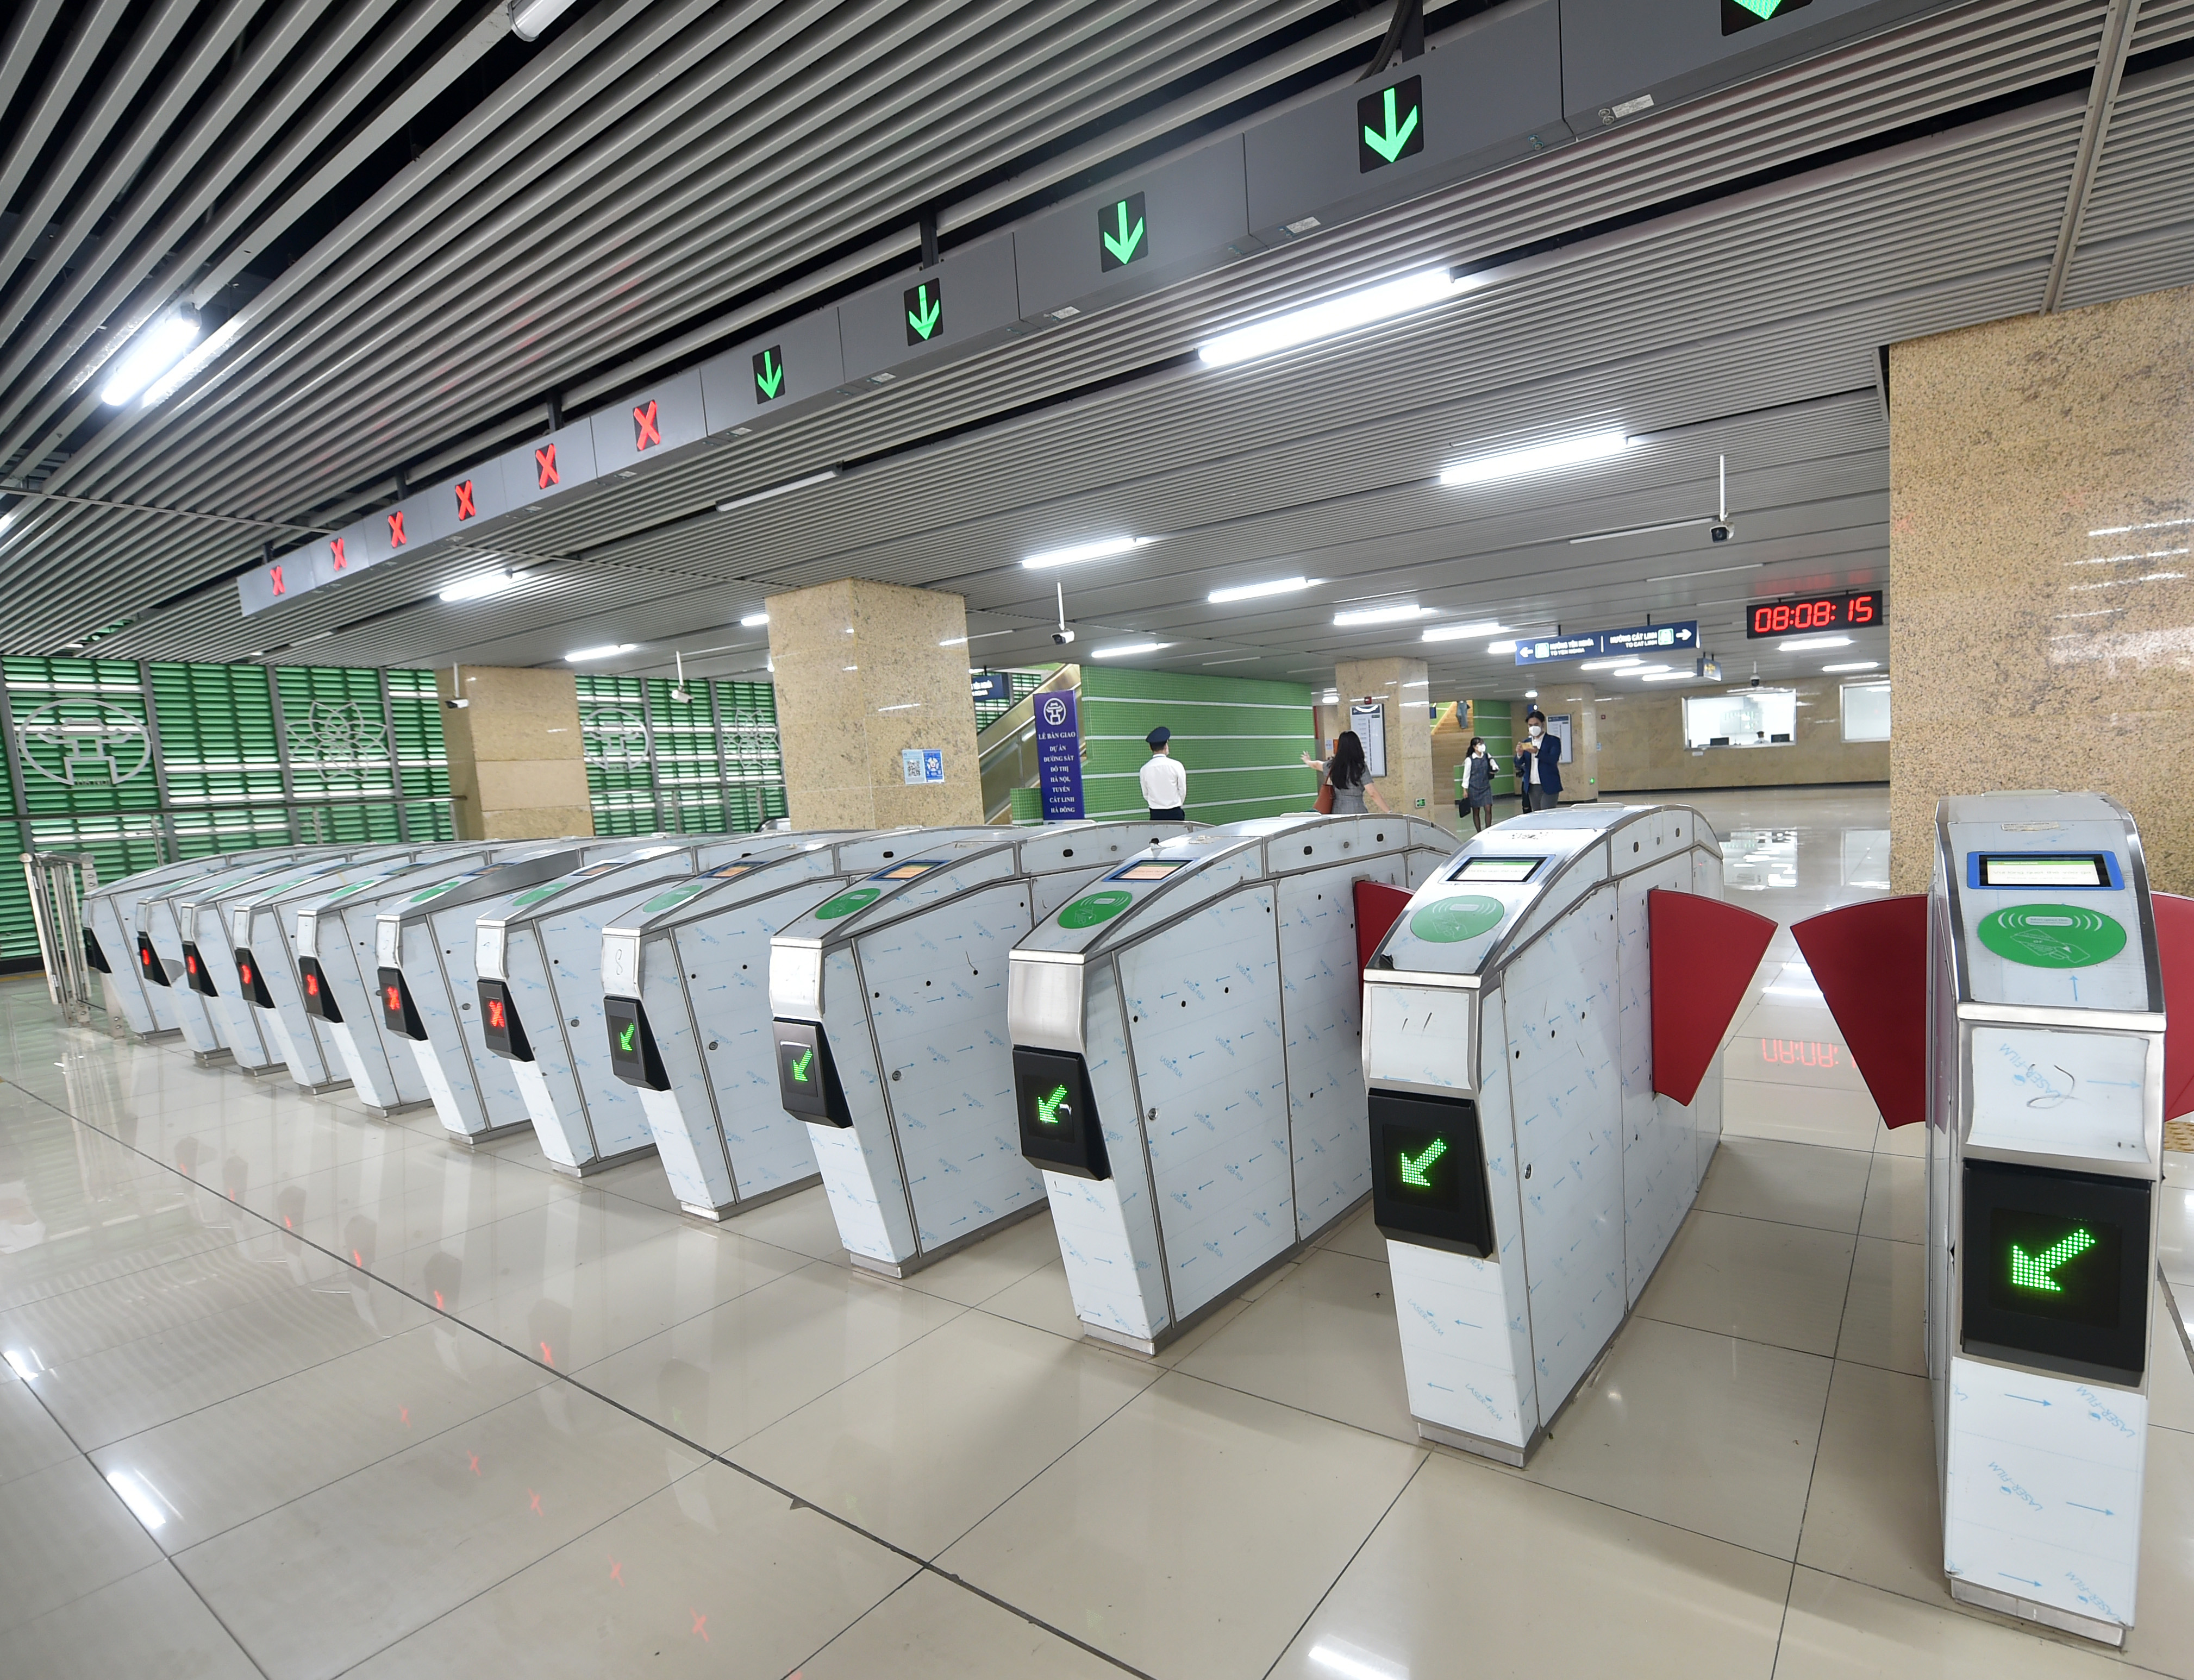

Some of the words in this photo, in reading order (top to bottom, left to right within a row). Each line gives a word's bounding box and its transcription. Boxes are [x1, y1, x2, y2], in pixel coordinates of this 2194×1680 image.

[1407, 1299, 1445, 1337] LASER-FILM
[1465, 1383, 1503, 1422] LASER-FILM
[2076, 1386, 2136, 1438] LASER-FILM
[1987, 1461, 2043, 1512] LASER-FILM
